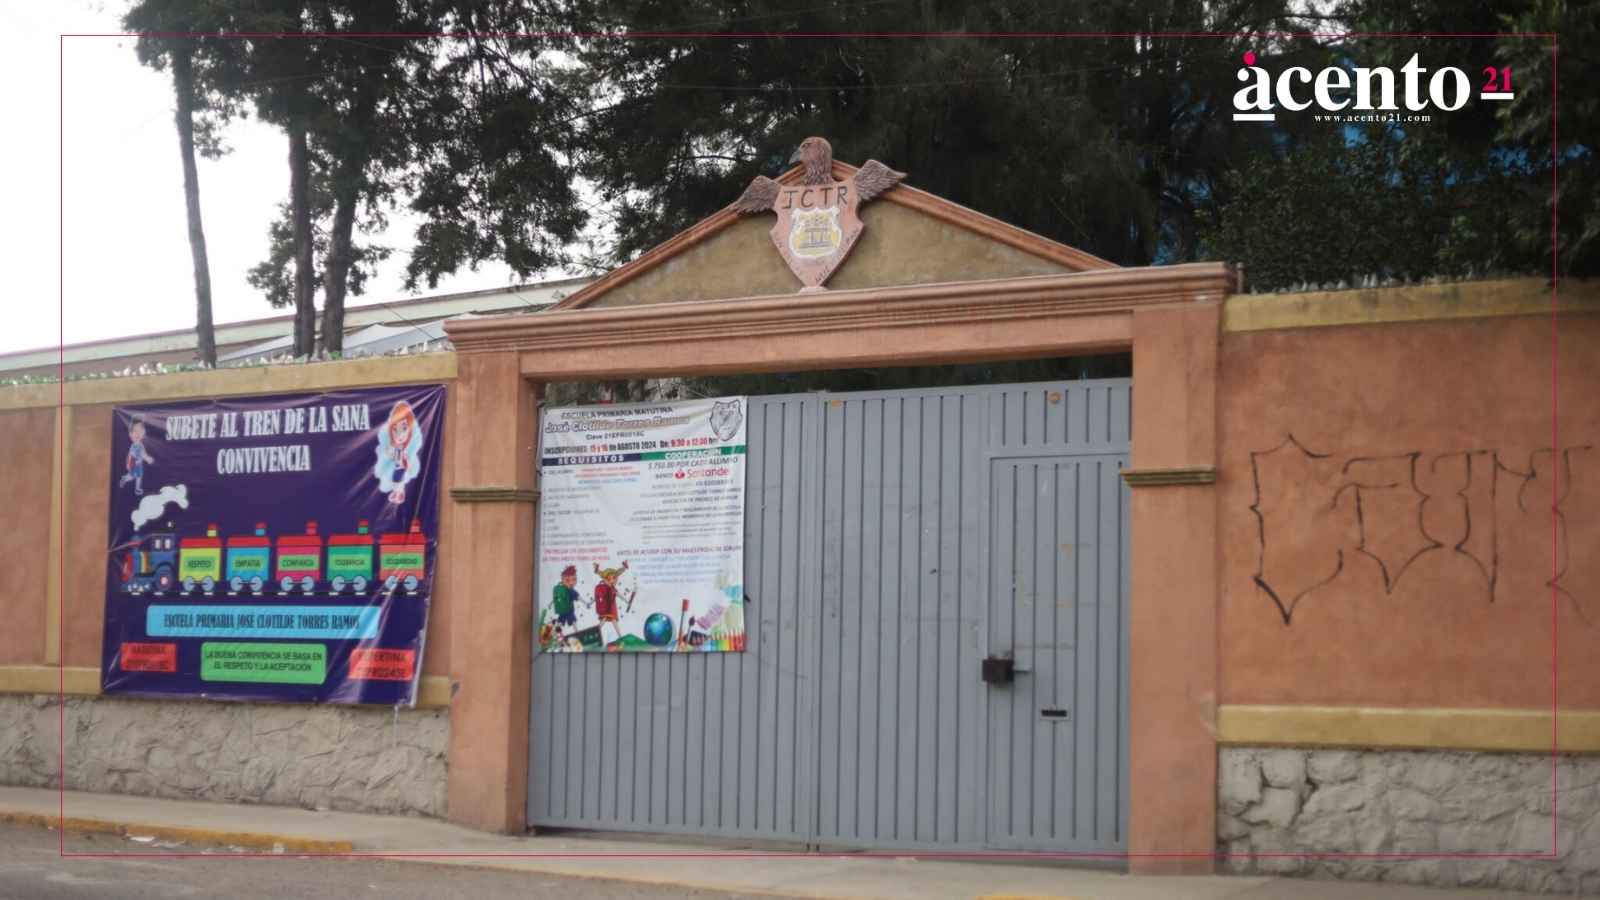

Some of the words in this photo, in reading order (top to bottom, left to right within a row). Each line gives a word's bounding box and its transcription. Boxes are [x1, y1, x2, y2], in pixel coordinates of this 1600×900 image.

[782, 186, 848, 209] JCTR
[166, 413, 217, 440] SUBETE
[220, 412, 238, 437] AL
[243, 409, 281, 436] TREN
[284, 407, 304, 434] DE
[308, 406, 327, 432] LA
[332, 404, 370, 432] SANA
[641, 440, 657, 449] 2024
[216, 445, 311, 474] CONVIVENCIA
[558, 454, 625, 465] REQUISITOS
[298, 614, 328, 630] TORRES
